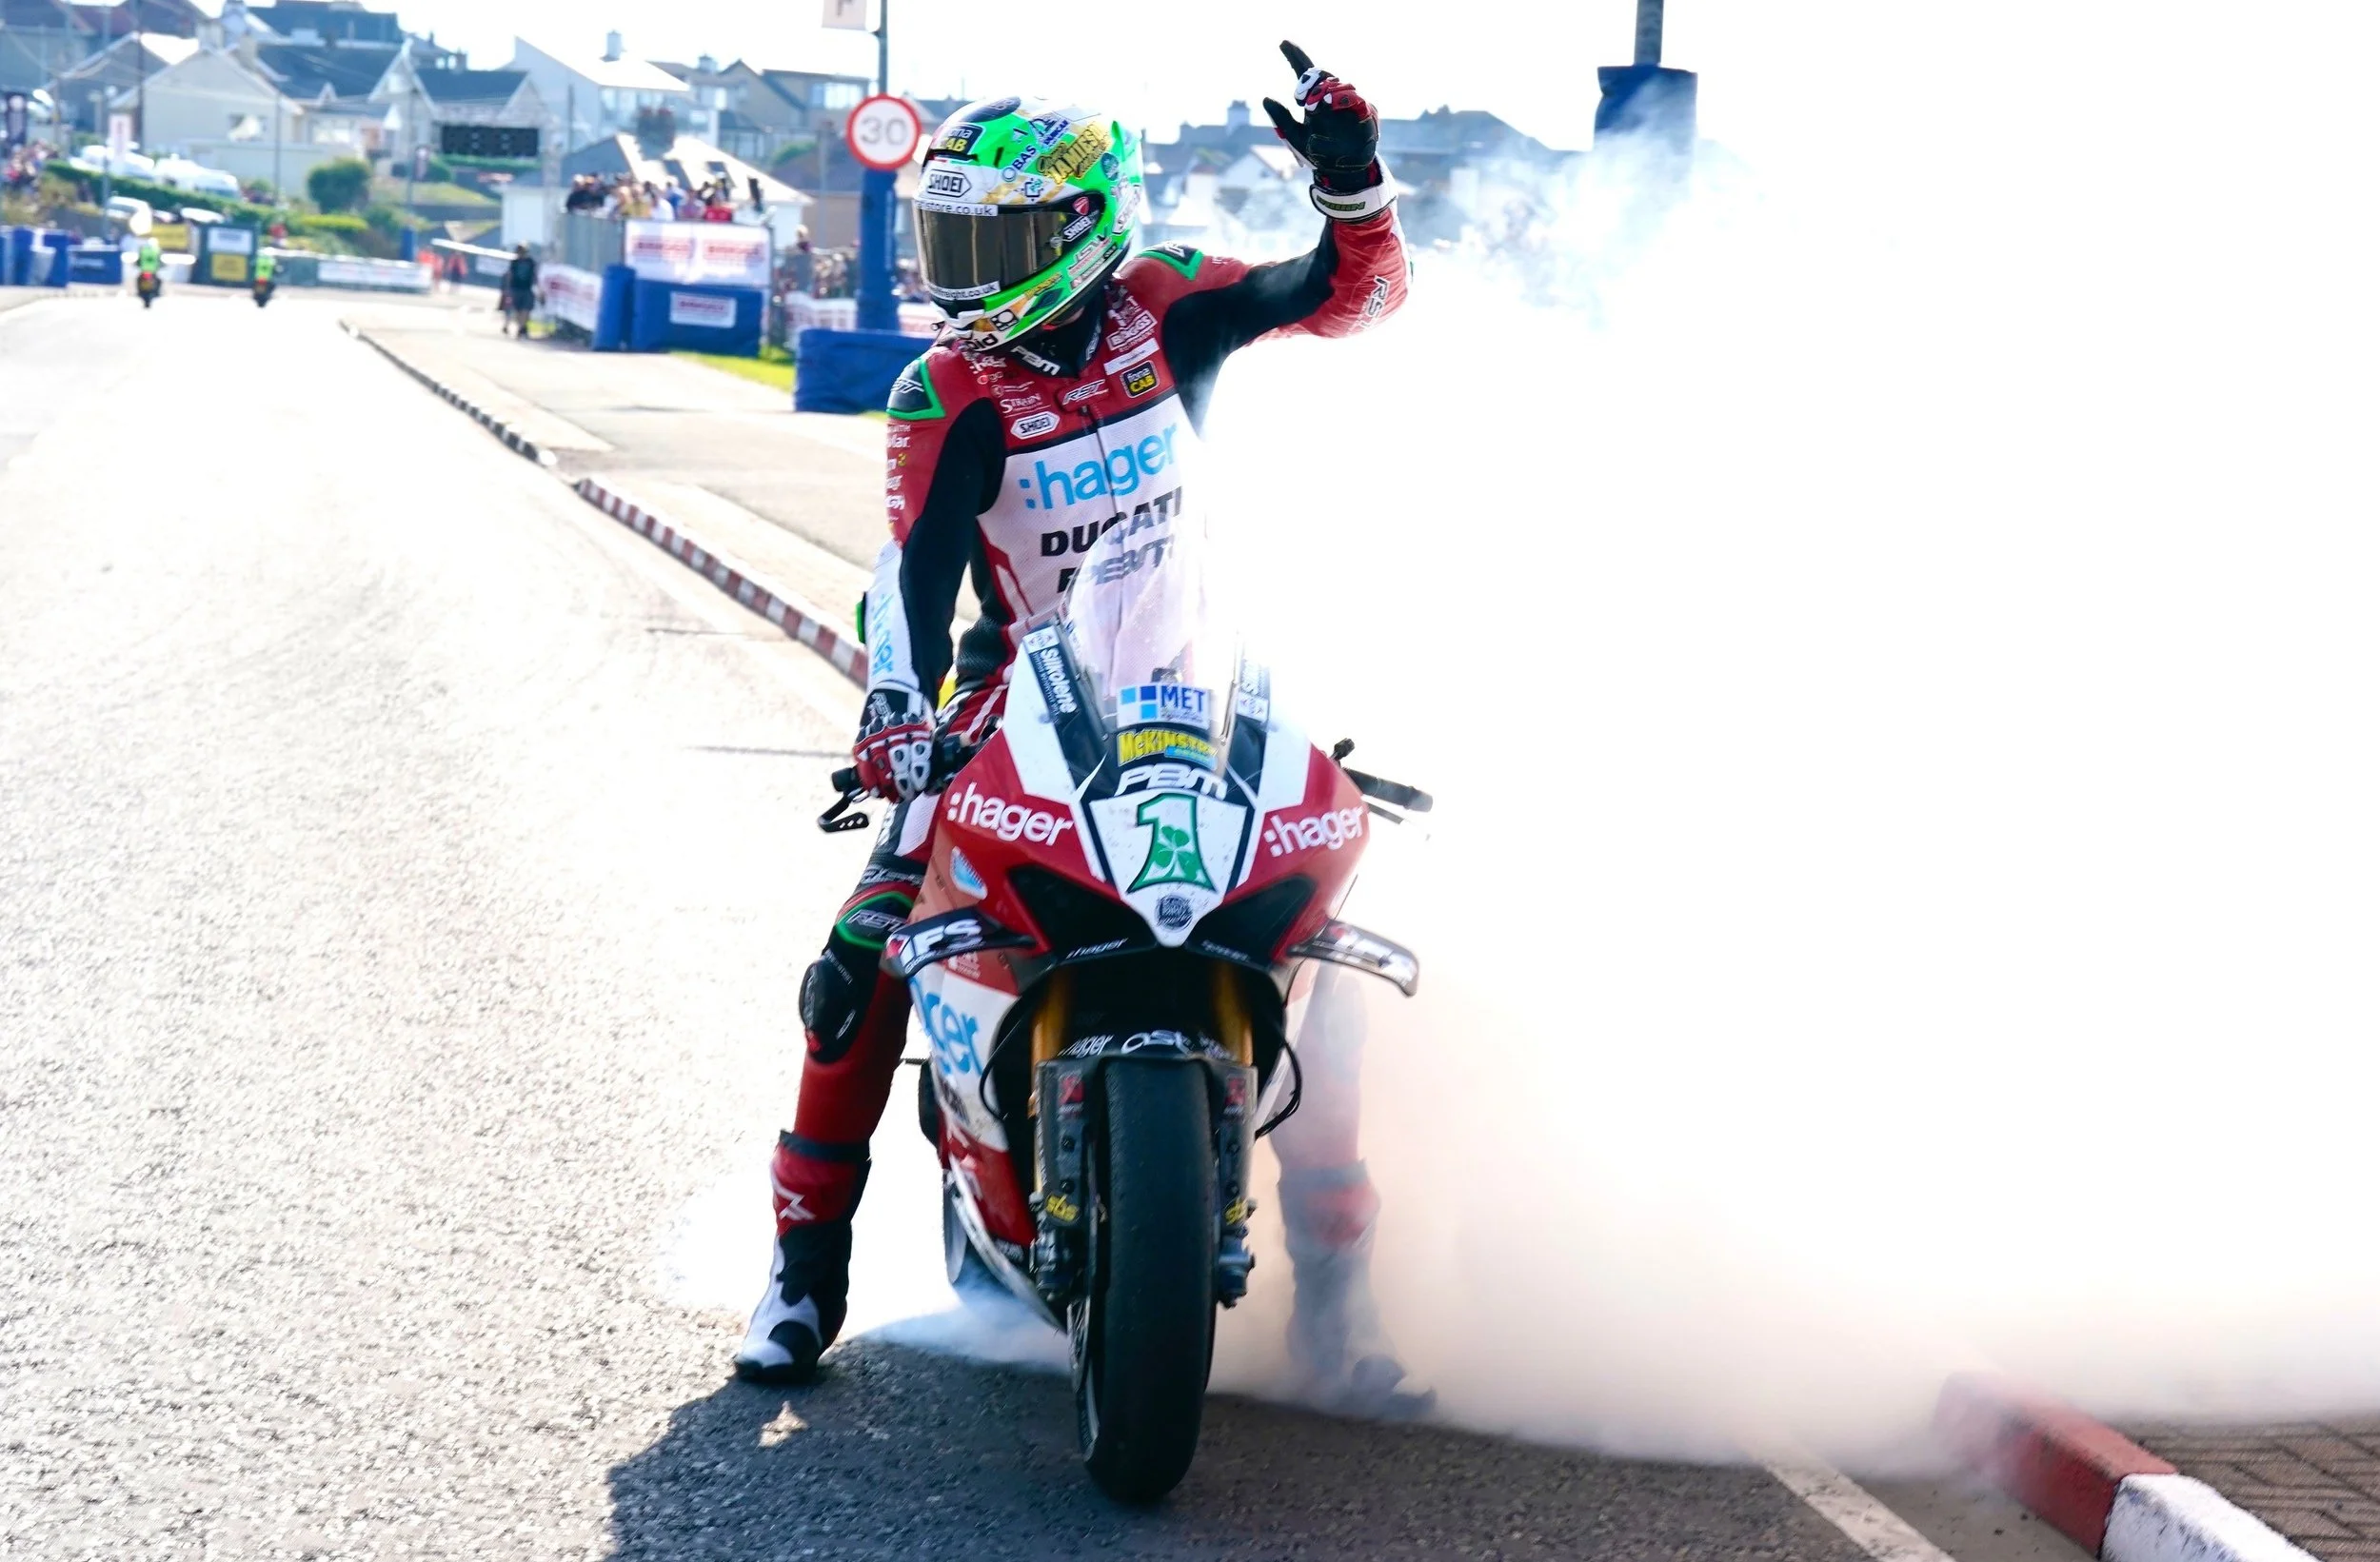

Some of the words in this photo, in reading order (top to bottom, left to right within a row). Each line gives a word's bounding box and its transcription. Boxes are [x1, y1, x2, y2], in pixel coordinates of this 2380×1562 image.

[861, 115, 907, 145] 30
[928, 173, 963, 193] SHOEI
[1062, 215, 1093, 240] SHOEI
[1129, 375, 1155, 394] CAB
[1020, 416, 1052, 434] SHOEI
[1041, 486, 1182, 557] DUCATI
[1160, 684, 1205, 712] MET
[1127, 793, 1217, 894] 1
